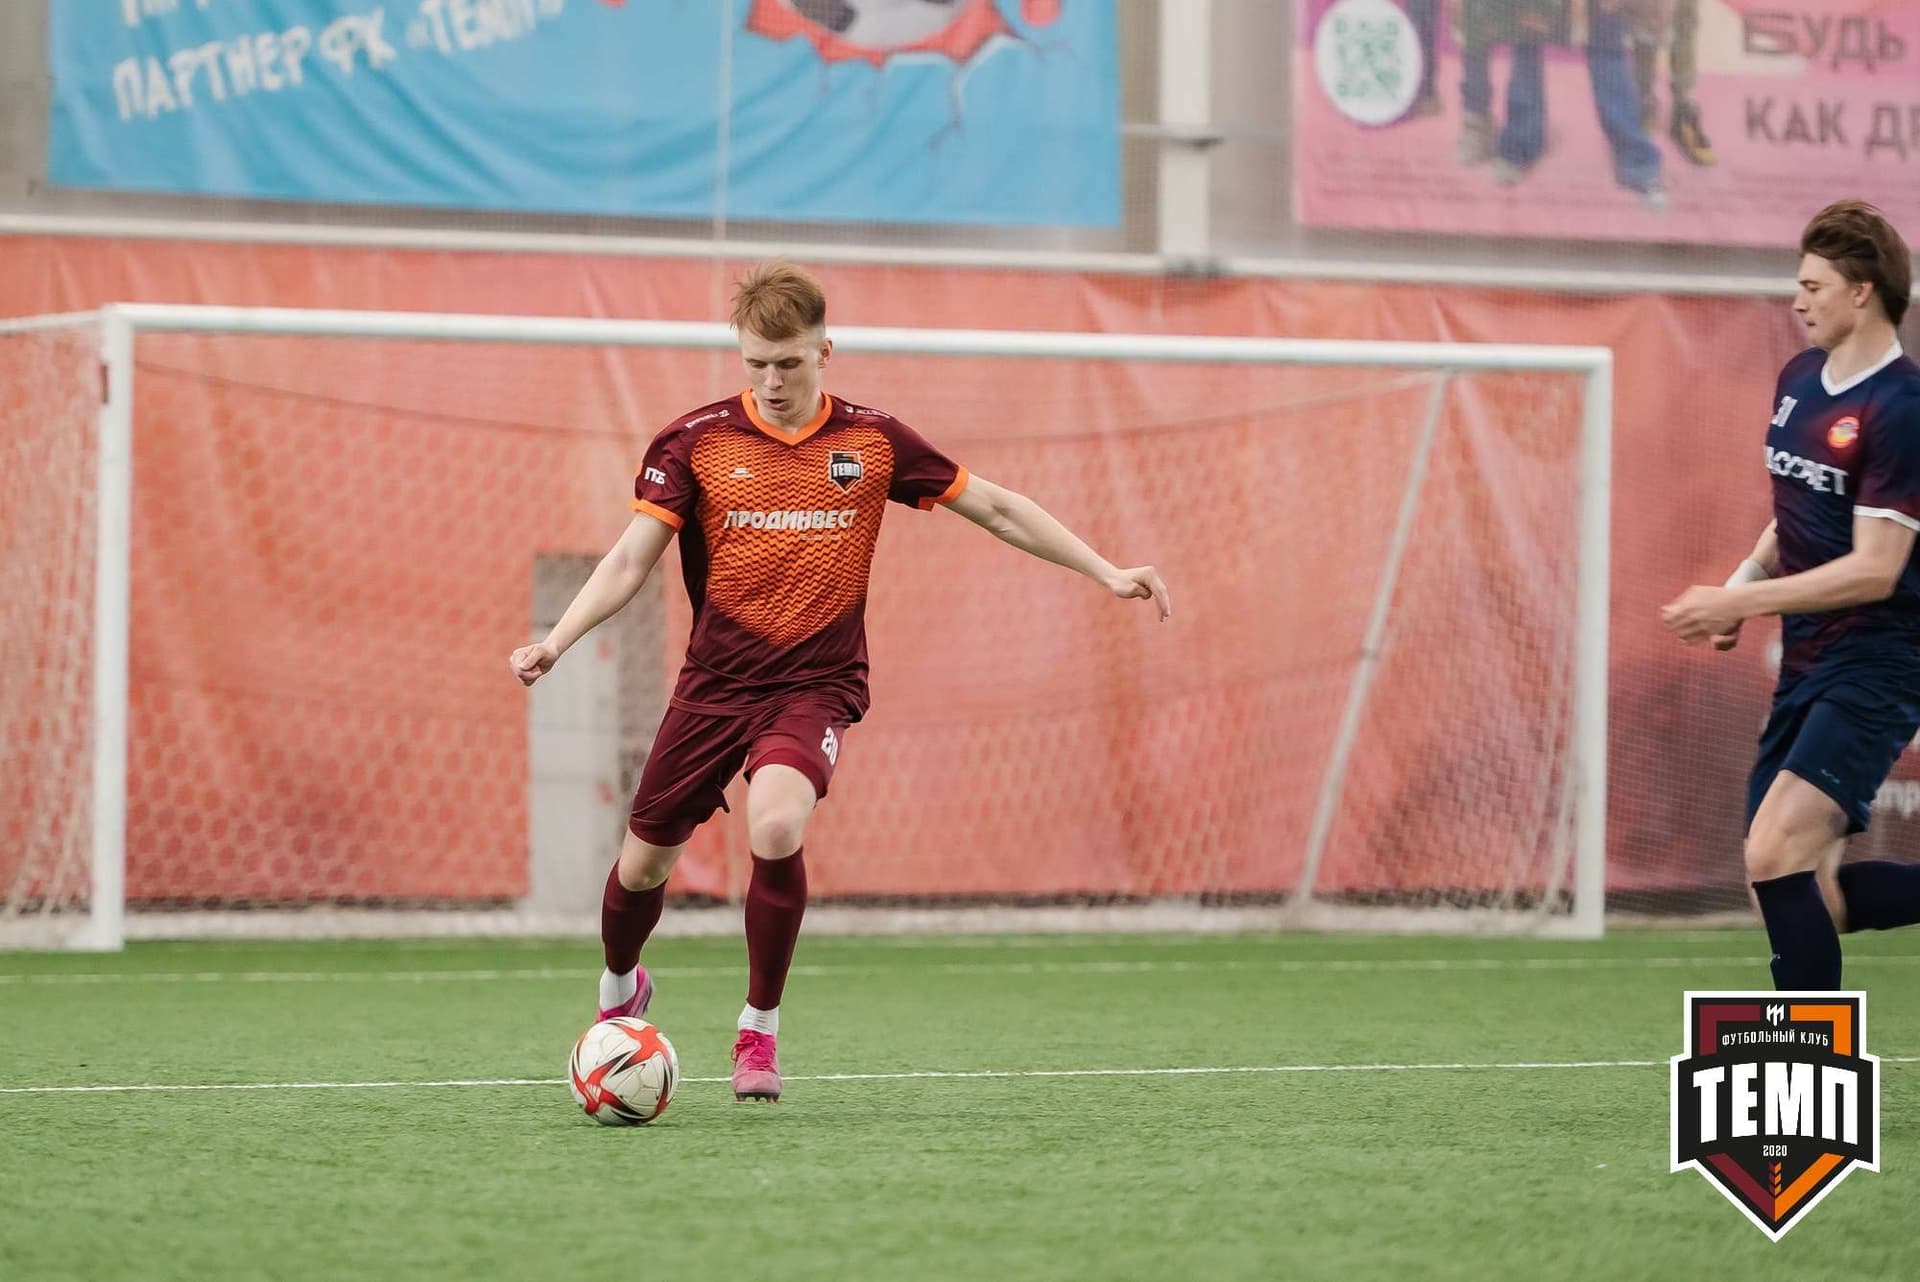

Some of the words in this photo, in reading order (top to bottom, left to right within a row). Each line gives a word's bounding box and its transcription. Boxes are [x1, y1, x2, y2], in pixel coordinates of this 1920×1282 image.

[318, 7, 397, 73] ФК
[1743, 12, 1907, 73] БУДЬ
[1744, 97, 1848, 145] КАК
[723, 509, 857, 530] ПРОДИНВЕСТ
